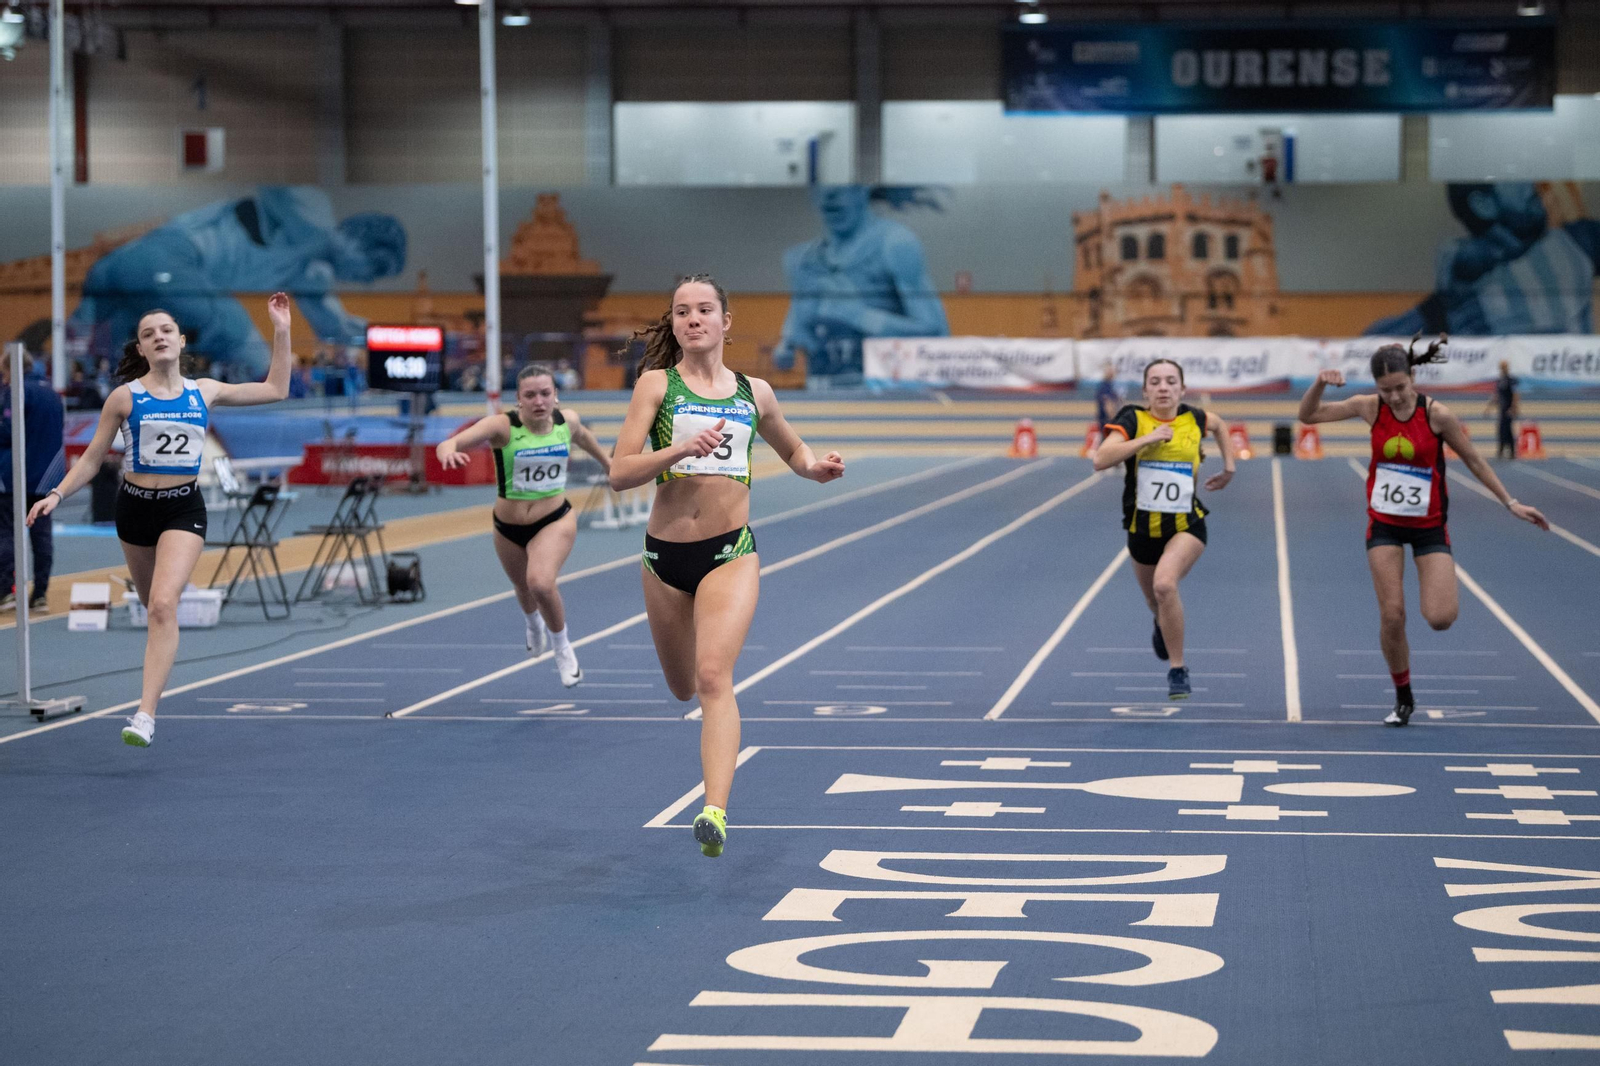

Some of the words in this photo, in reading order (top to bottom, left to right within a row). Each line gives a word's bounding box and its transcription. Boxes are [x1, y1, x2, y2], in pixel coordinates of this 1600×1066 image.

[1171, 48, 1392, 88] OURENSE
[142, 412, 181, 420] OURENSE
[182, 411, 202, 419] 2026
[677, 405, 723, 414] OURENSE
[724, 408, 749, 416] 2026
[155, 433, 190, 455] 22
[694, 433, 734, 461] 3
[520, 463, 561, 482] 160
[123, 482, 154, 500] NIKE
[156, 485, 191, 500] PRO
[1151, 481, 1180, 502] 70
[1381, 483, 1422, 506] 163
